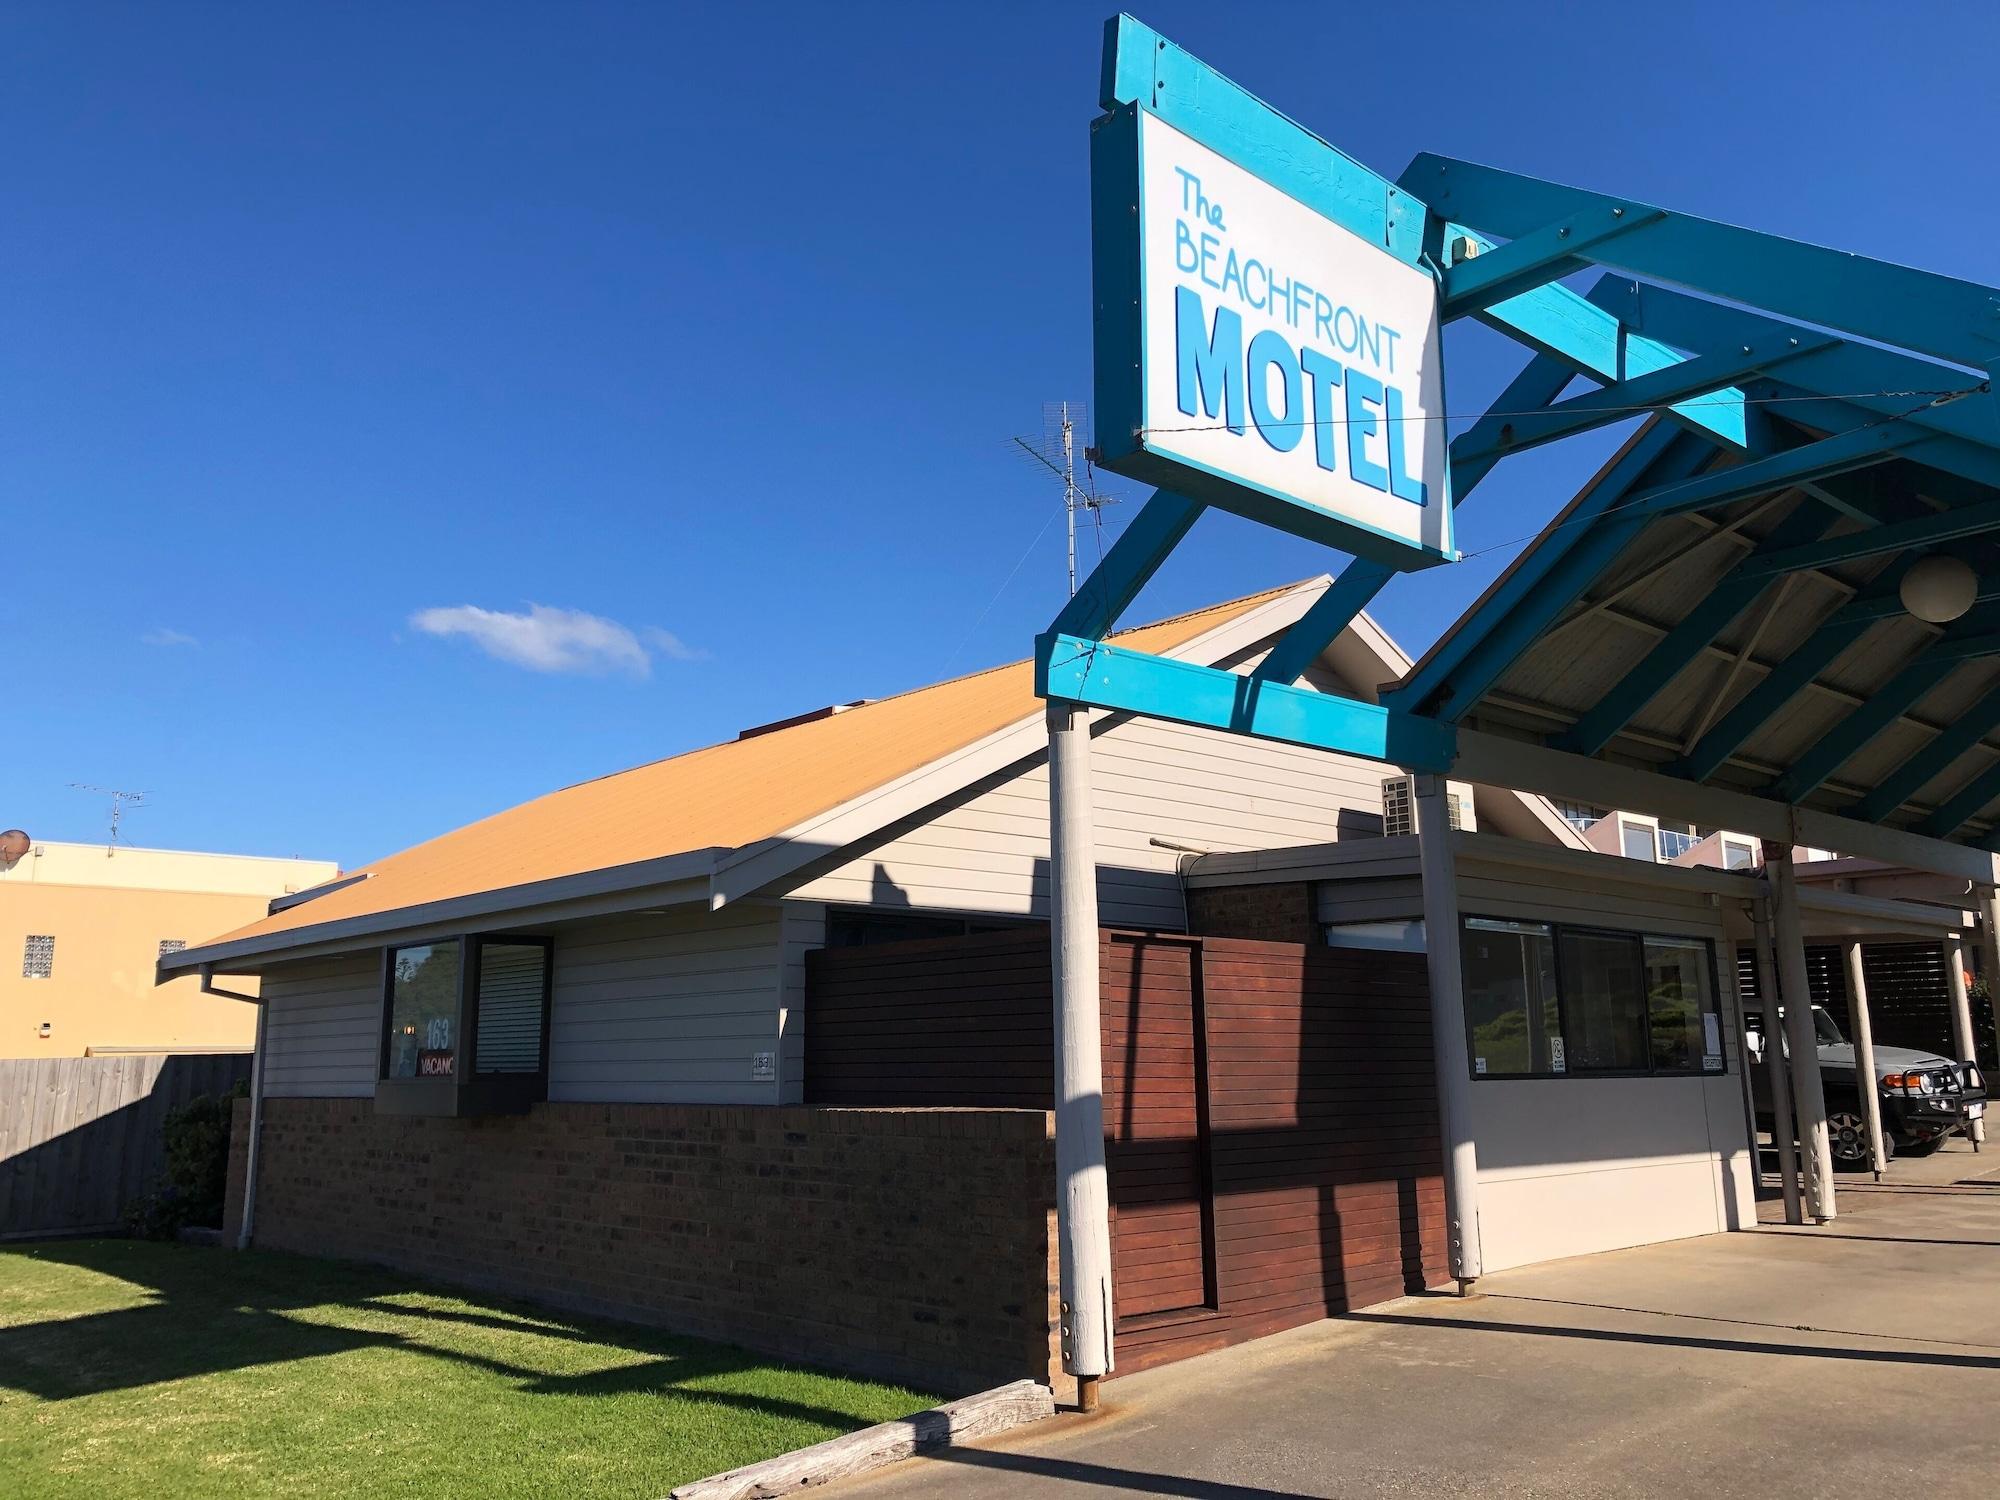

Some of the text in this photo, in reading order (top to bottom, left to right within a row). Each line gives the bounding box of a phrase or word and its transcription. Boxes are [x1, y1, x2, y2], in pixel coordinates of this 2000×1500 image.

[1174, 165, 1227, 232] The
[1175, 219, 1401, 374] BEACHFRONT
[1175, 284, 1428, 508] MOTEL
[421, 1056, 454, 1075] VACANC
[427, 1018, 449, 1049] 163
